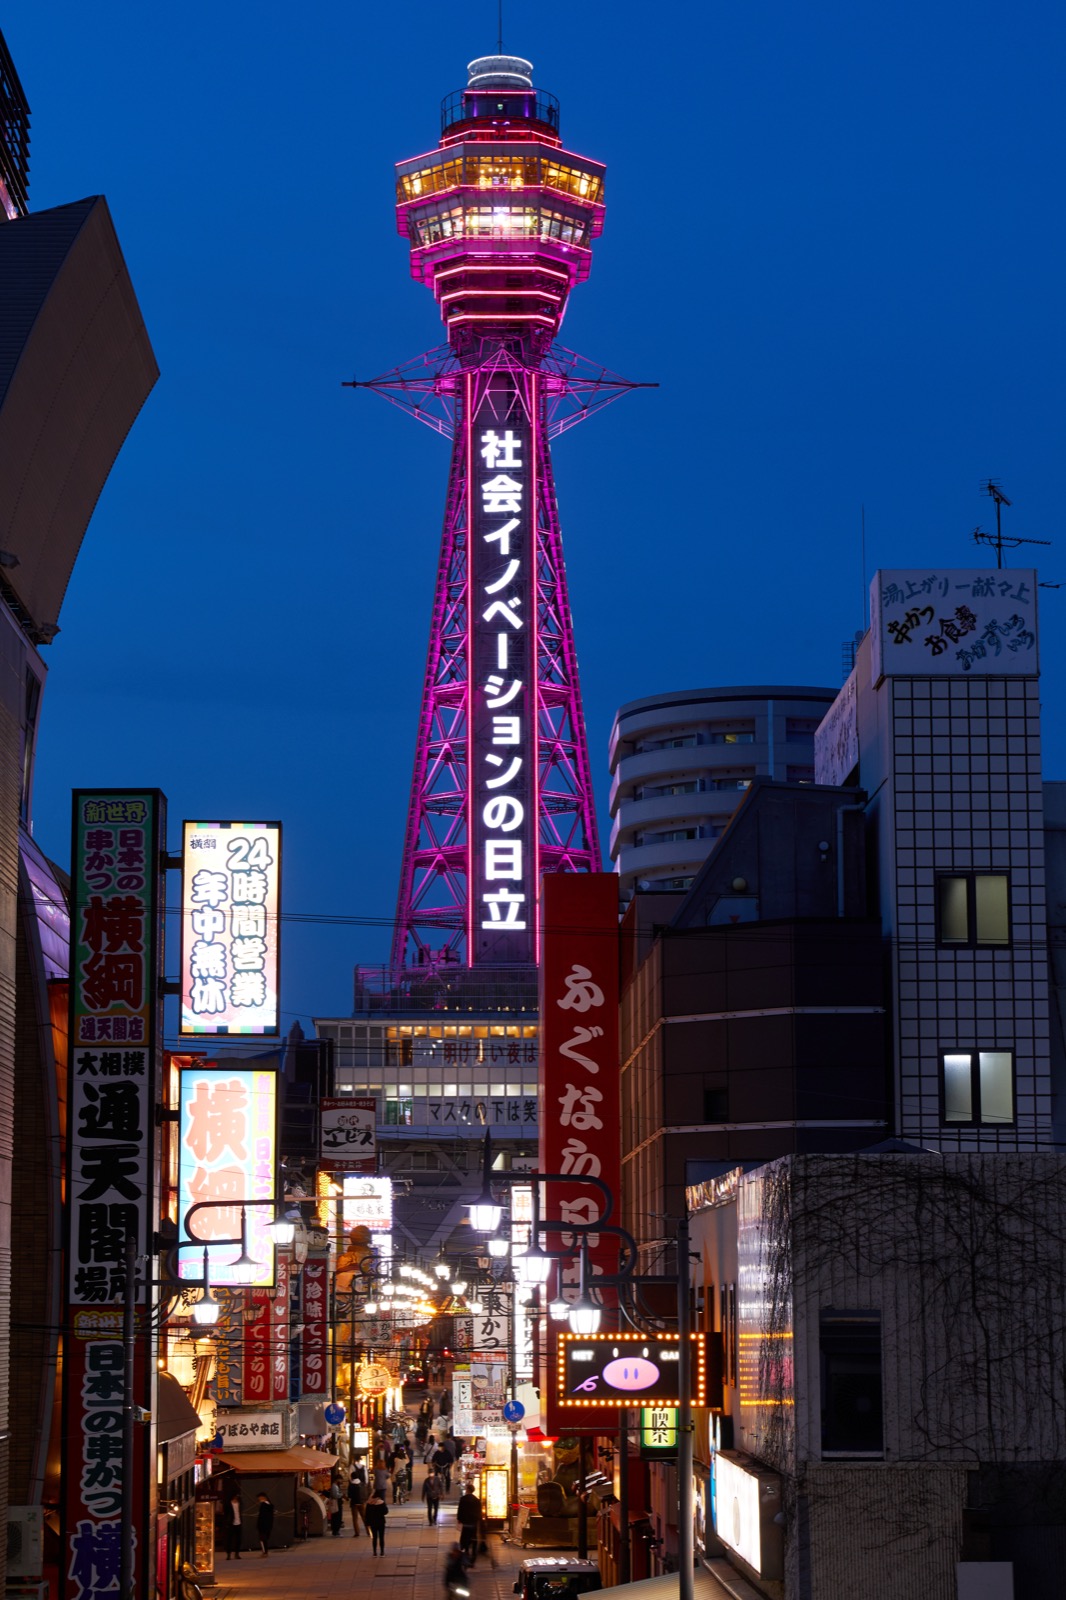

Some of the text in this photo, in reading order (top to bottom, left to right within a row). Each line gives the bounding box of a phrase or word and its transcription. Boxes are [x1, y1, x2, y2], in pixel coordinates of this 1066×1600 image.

[887, 605, 935, 645] 串かつ
[480, 429, 526, 931] 社会イノベーションの日立
[85, 801, 147, 823] 新世界
[83, 829, 115, 891] 串かつ
[116, 829, 145, 891] 日本一の
[81, 893, 145, 1012] 横綱
[190, 869, 229, 1015] 年中無休
[226, 836, 274, 1007] 24時間営業
[79, 1014, 144, 1043] 通天閣店
[76, 1051, 146, 1077] 大相撲
[186, 1080, 249, 1241] 横綱
[571, 1350, 595, 1361] NET
